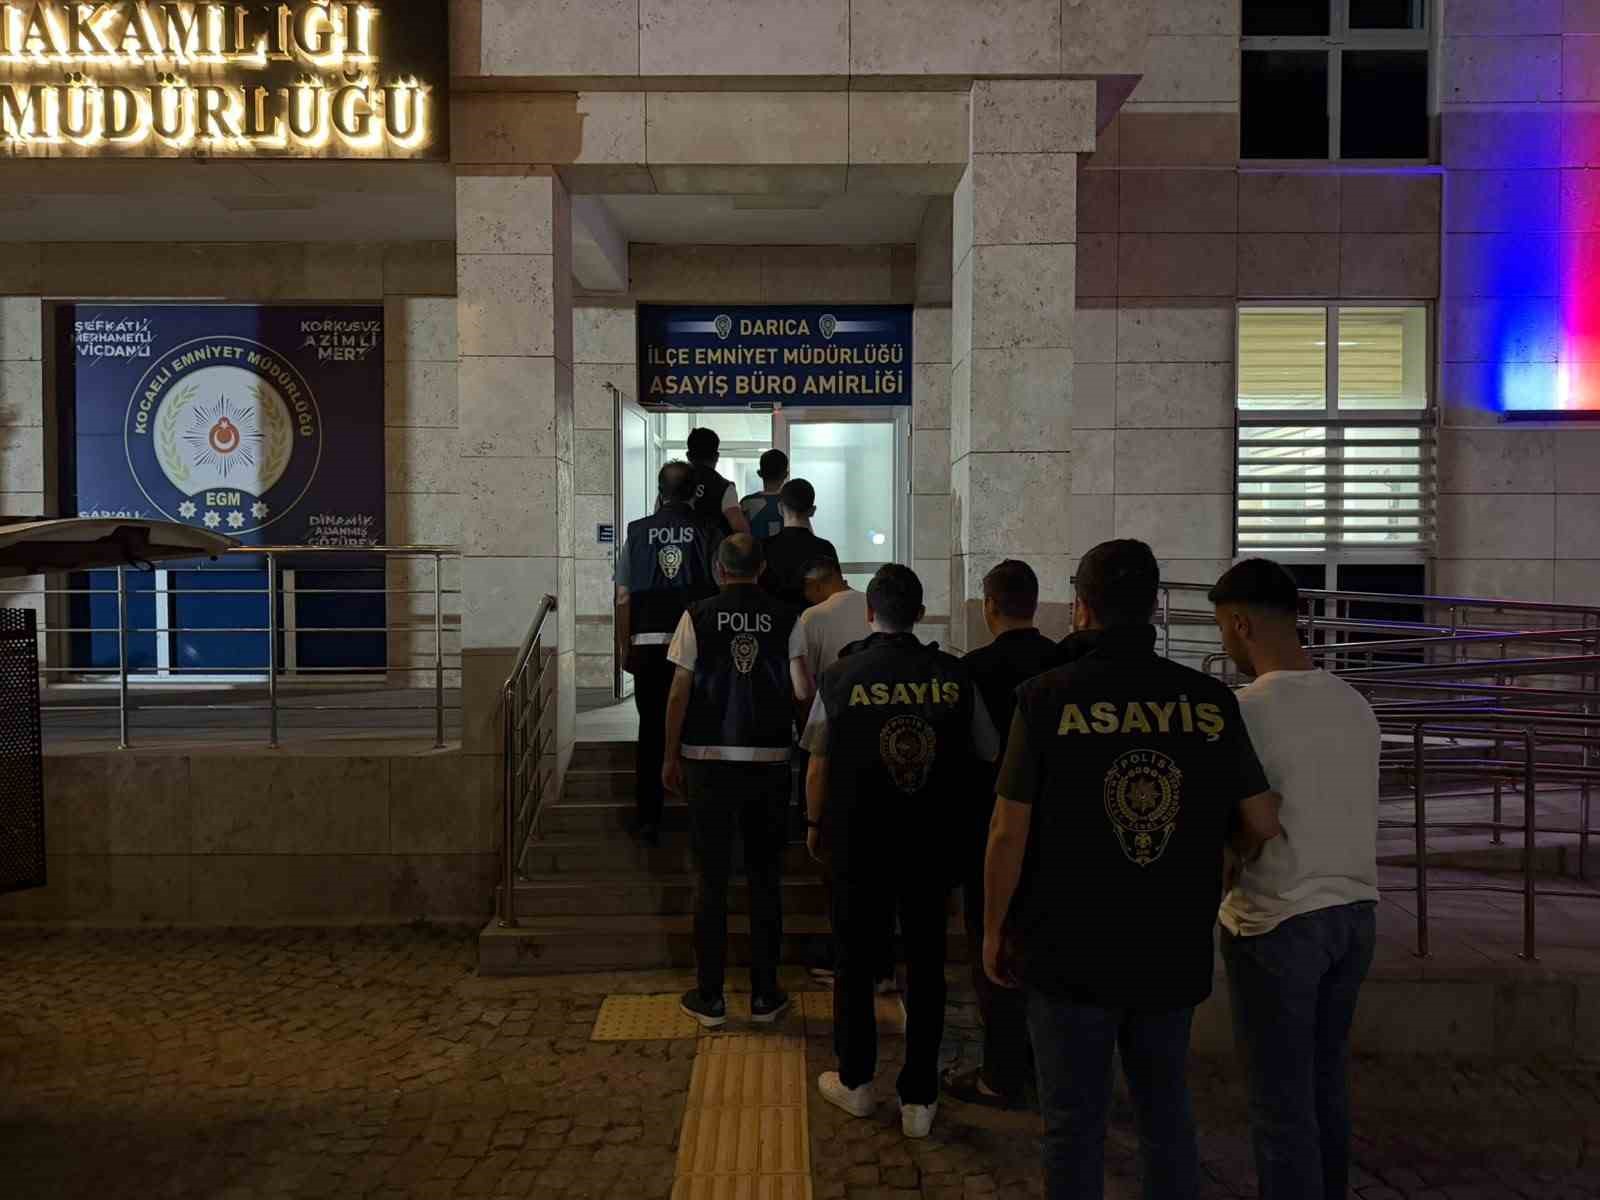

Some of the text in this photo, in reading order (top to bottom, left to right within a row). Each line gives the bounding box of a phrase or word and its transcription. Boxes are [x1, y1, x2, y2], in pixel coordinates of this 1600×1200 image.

[0, 0, 374, 58] AKAMLIĞI
[0, 64, 422, 140] MÜDÜRLÜĞÜ
[304, 332, 377, 347] AZİMLİ
[740, 319, 810, 336] DARICA
[318, 347, 367, 360] MERT
[647, 343, 903, 367] İLÇE EMNİYET MÜDÜRLÜĞÜ
[136, 345, 314, 436] KOCAELİ EMNİYET MÜDÜRLÜĞÜ
[650, 370, 903, 397] ASAYİŞ BÜRO AMİRLİĞİ
[206, 492, 241, 506] EGM
[848, 678, 961, 709] ASAYİŞ
[1056, 694, 1225, 743] ASAYİŞ
